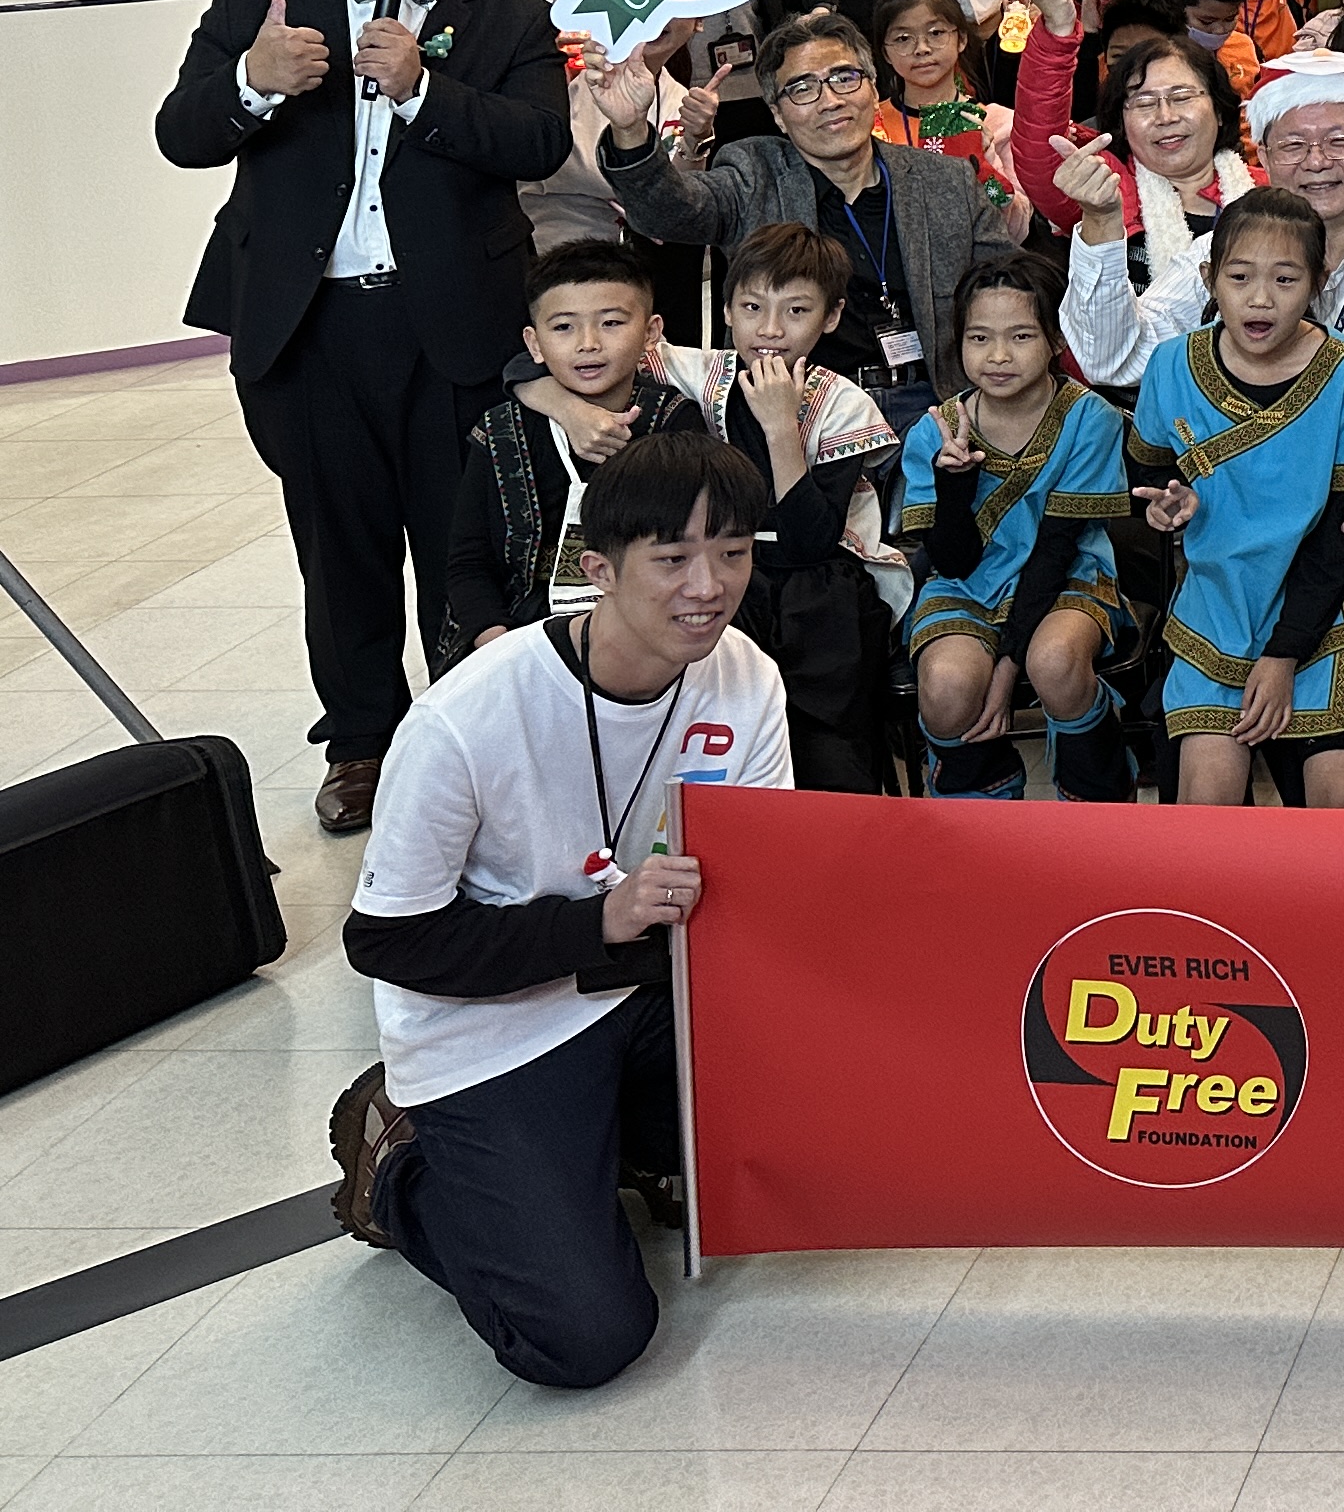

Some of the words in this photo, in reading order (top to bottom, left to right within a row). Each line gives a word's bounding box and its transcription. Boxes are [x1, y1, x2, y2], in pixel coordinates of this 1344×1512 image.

[1108, 954, 1177, 978] EVER
[1186, 958, 1250, 981] RICH
[1065, 979, 1230, 1061] Duty
[1106, 1067, 1279, 1141] Free
[1137, 1130, 1258, 1150] FOUNDATION
